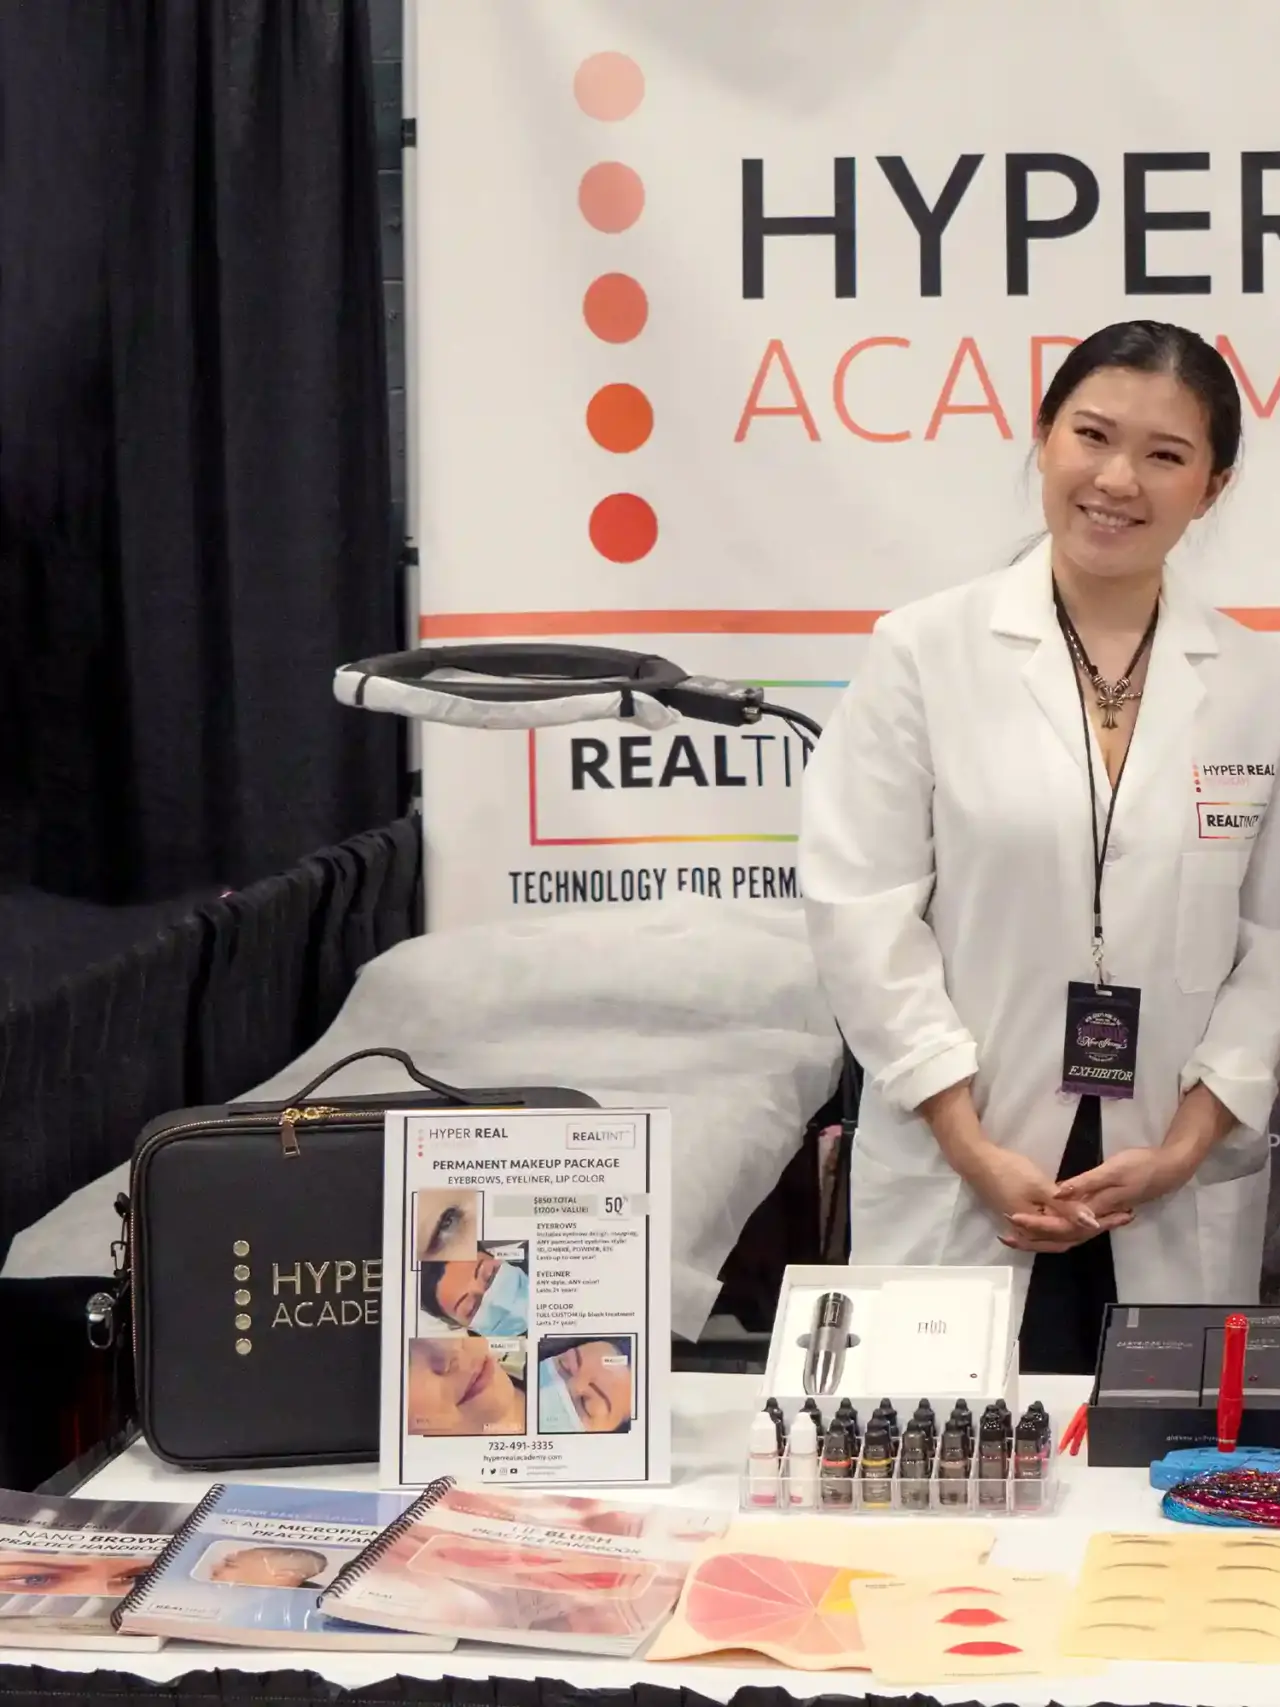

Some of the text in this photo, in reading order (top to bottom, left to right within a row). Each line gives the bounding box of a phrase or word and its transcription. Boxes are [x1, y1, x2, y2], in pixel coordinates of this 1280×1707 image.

[1203, 764, 1276, 776] HYPER REAL
[509, 868, 667, 904] TECHNOLOGY
[732, 866, 804, 899] PERM
[1068, 1065, 1134, 1081] EXHIBITOR
[429, 1127, 509, 1140] HYPER REAL
[432, 1157, 621, 1171] PERMANENT MAKEUP PACKAGE
[447, 1173, 606, 1186] EYEBROWS, EYELINER, LIP COLOR
[553, 1196, 577, 1204] TOTAL
[536, 1222, 577, 1230] EYEBROWS
[536, 1270, 571, 1278] EYELINER
[536, 1303, 548, 1311] LIP
[271, 1299, 380, 1329] ACADE
[488, 1440, 555, 1451] 732-491-3335
[19, 1530, 85, 1542] NANO
[251, 1530, 335, 1541] PRACTICE
[544, 1530, 613, 1544] BLUSH
[0, 1537, 75, 1549] PRACTICE
